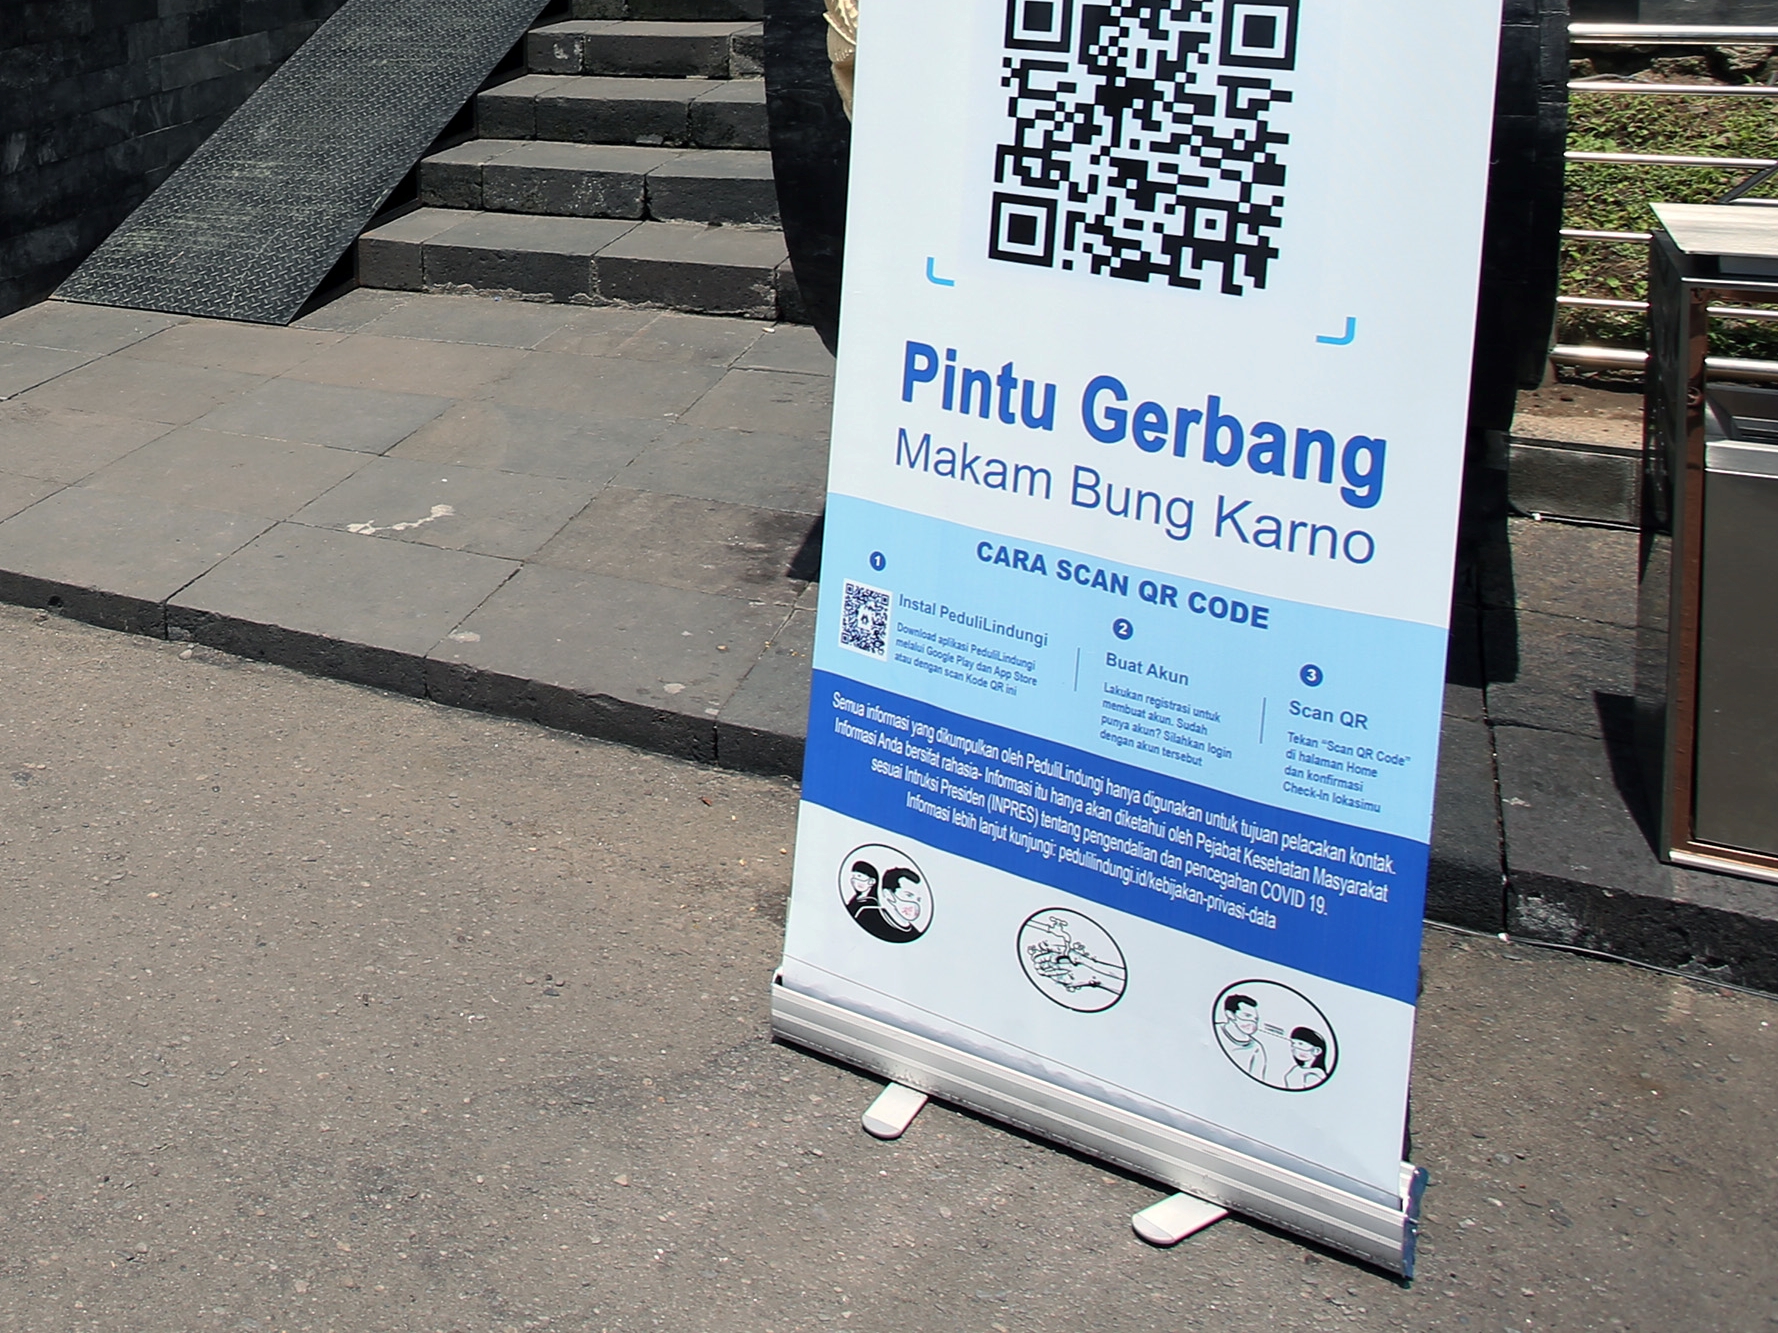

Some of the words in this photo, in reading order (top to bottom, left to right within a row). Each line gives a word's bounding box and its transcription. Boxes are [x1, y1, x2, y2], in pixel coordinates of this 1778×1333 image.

[900, 339, 1057, 433] Pintu
[1079, 373, 1388, 510] Gerbang
[894, 426, 1054, 500] Makam
[1070, 464, 1194, 541] Bung
[1214, 493, 1377, 566] Karno
[976, 541, 1048, 576] CARA
[1055, 558, 1129, 597] SCAN
[1138, 580, 1179, 609] QR
[1188, 591, 1269, 630] CODE
[899, 593, 936, 615] Instal
[939, 605, 1050, 649] PeduliLindungi
[895, 638, 925, 654] melalui
[926, 645, 955, 664] Google
[956, 655, 975, 671] Play
[976, 661, 993, 675] dan
[993, 666, 1012, 681] App
[1013, 671, 1038, 687] Store
[896, 621, 937, 642] Download
[938, 636, 970, 653] aplikasi
[970, 643, 1037, 673] PeduliLindungi
[1105, 651, 1143, 675] Buat
[1146, 663, 1190, 687] Akun
[894, 651, 912, 665] atau
[913, 657, 943, 674] dengan
[944, 667, 964, 682] scan
[965, 672, 989, 688] Kode
[989, 679, 1005, 693] QR
[1005, 683, 1018, 697] ini
[1102, 699, 1146, 719] membuat
[1147, 710, 1174, 726] akun.
[1176, 718, 1208, 736] Sudah
[1103, 682, 1143, 702] Lakukan
[1145, 695, 1191, 716] registrasi
[1193, 707, 1221, 724] untuk
[1288, 699, 1334, 724] Scan
[1339, 710, 1369, 731] QR
[1099, 729, 1135, 748] dengan
[1136, 740, 1160, 755] akun
[1162, 746, 1204, 767] tersebut
[1101, 715, 1130, 733] punya
[1131, 722, 1162, 739] akun?
[1163, 731, 1205, 752] Silahkan
[1207, 742, 1233, 760] login
[1287, 731, 1319, 749] Tekan
[1356, 746, 1374, 762] QR
[832, 691, 865, 717] Semua
[866, 702, 910, 732] informasi
[910, 719, 935, 744] yang
[936, 727, 999, 761] dikumpulkan
[1001, 747, 1024, 768] oleh
[1025, 753, 1105, 797] PeduliLindungi
[1106, 777, 1141, 806] hanya
[1142, 789, 1203, 823] digunakan
[1205, 809, 1239, 834] untuk
[1241, 818, 1279, 845] tujuan
[1280, 832, 1347, 864] pelacakan
[1348, 846, 1397, 875] kontak.
[1284, 764, 1305, 780] dan
[1306, 768, 1364, 793] konfirmasi
[1285, 748, 1296, 761] di
[1298, 751, 1344, 772] halaman
[1346, 761, 1379, 778] Home
[834, 717, 878, 747] Informasi
[878, 730, 903, 755] Anda
[905, 739, 940, 766] bersifat
[984, 766, 1034, 797] Informasi
[1034, 781, 1049, 802] itu
[1050, 786, 1084, 814] hanya
[1085, 800, 1113, 823] akan
[1114, 807, 1167, 839] diketahui
[1168, 822, 1194, 848] oleh
[1196, 830, 1242, 862] Pejabat
[1242, 846, 1310, 883] Kesehatan
[1312, 866, 1389, 903] Masyarakat
[1282, 781, 1330, 802] Check-In
[1332, 790, 1382, 814] lokasimu
[871, 755, 904, 779] sesuai
[904, 765, 940, 793] Intruksi
[940, 777, 986, 808] Presiden
[987, 793, 1039, 829] (INPRES)
[1040, 810, 1082, 843] tentang
[1082, 826, 1158, 864] pengendalian
[1159, 848, 1185, 872] dan
[1184, 855, 1258, 897] pencegahan
[1260, 879, 1306, 909] COVID
[1309, 893, 1329, 916] 19.
[906, 790, 952, 823] Informasi
[952, 805, 978, 831] lebih
[978, 815, 1008, 842] lanjut
[1008, 825, 1057, 860] kunjungi:
